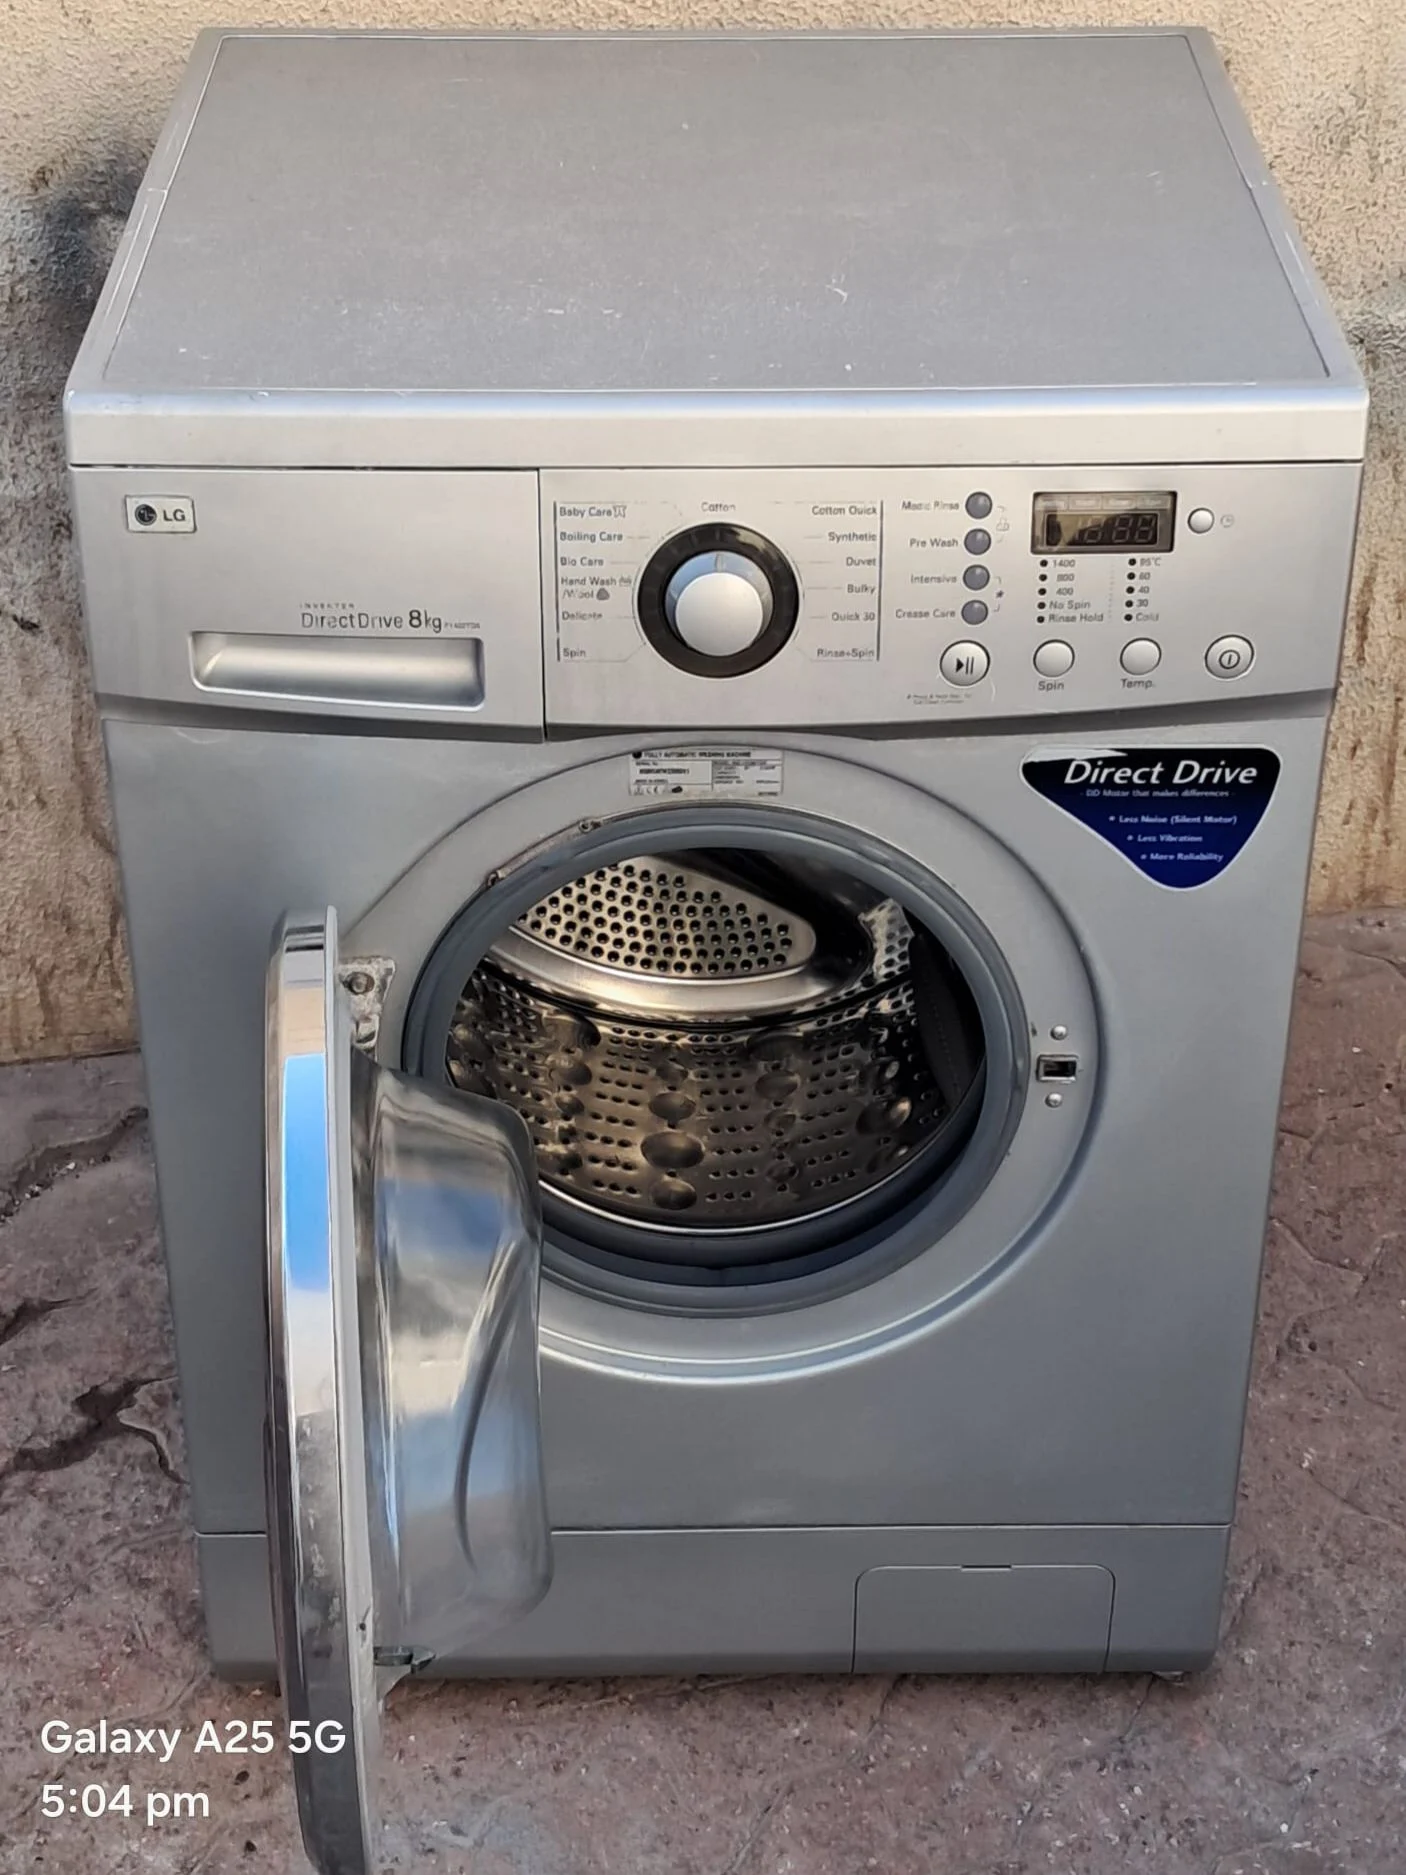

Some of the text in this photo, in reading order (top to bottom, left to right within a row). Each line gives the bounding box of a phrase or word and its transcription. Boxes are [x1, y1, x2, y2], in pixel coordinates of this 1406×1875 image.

[560, 506, 612, 518] Baby Care
[701, 502, 737, 512] Cotton
[812, 505, 878, 516] Cotton Quick
[162, 508, 186, 522] LG
[560, 531, 623, 543] Boiling Care
[828, 531, 877, 544] Synthetic
[910, 538, 958, 548] Pre Wash
[560, 556, 604, 566] Bio Care
[846, 556, 876, 566] Duvet
[1052, 559, 1076, 568] 1400
[560, 576, 616, 586] Hand Wash
[910, 574, 958, 584] Intensive
[847, 584, 876, 594] Bulky
[1138, 586, 1150, 594] 40
[1049, 600, 1091, 610] No Spin
[1136, 599, 1149, 608] 30
[831, 612, 876, 622] Quick 30
[932, 608, 956, 618] Care
[1048, 614, 1104, 622] Rinse Hold
[562, 648, 586, 658] Spin
[1038, 680, 1065, 692] Spin
[1120, 678, 1156, 689] Temp.
[1064, 760, 1258, 784] Direct Drive
[1103, 789, 1130, 797] Motor
[1132, 789, 1150, 797] that
[1152, 789, 1179, 797] makes
[1181, 788, 1230, 798] differences
[1118, 815, 1238, 825] Less Noise (Silent Motor)
[1137, 834, 1203, 843] Less Vibration
[1150, 852, 1224, 863] More Reliability
